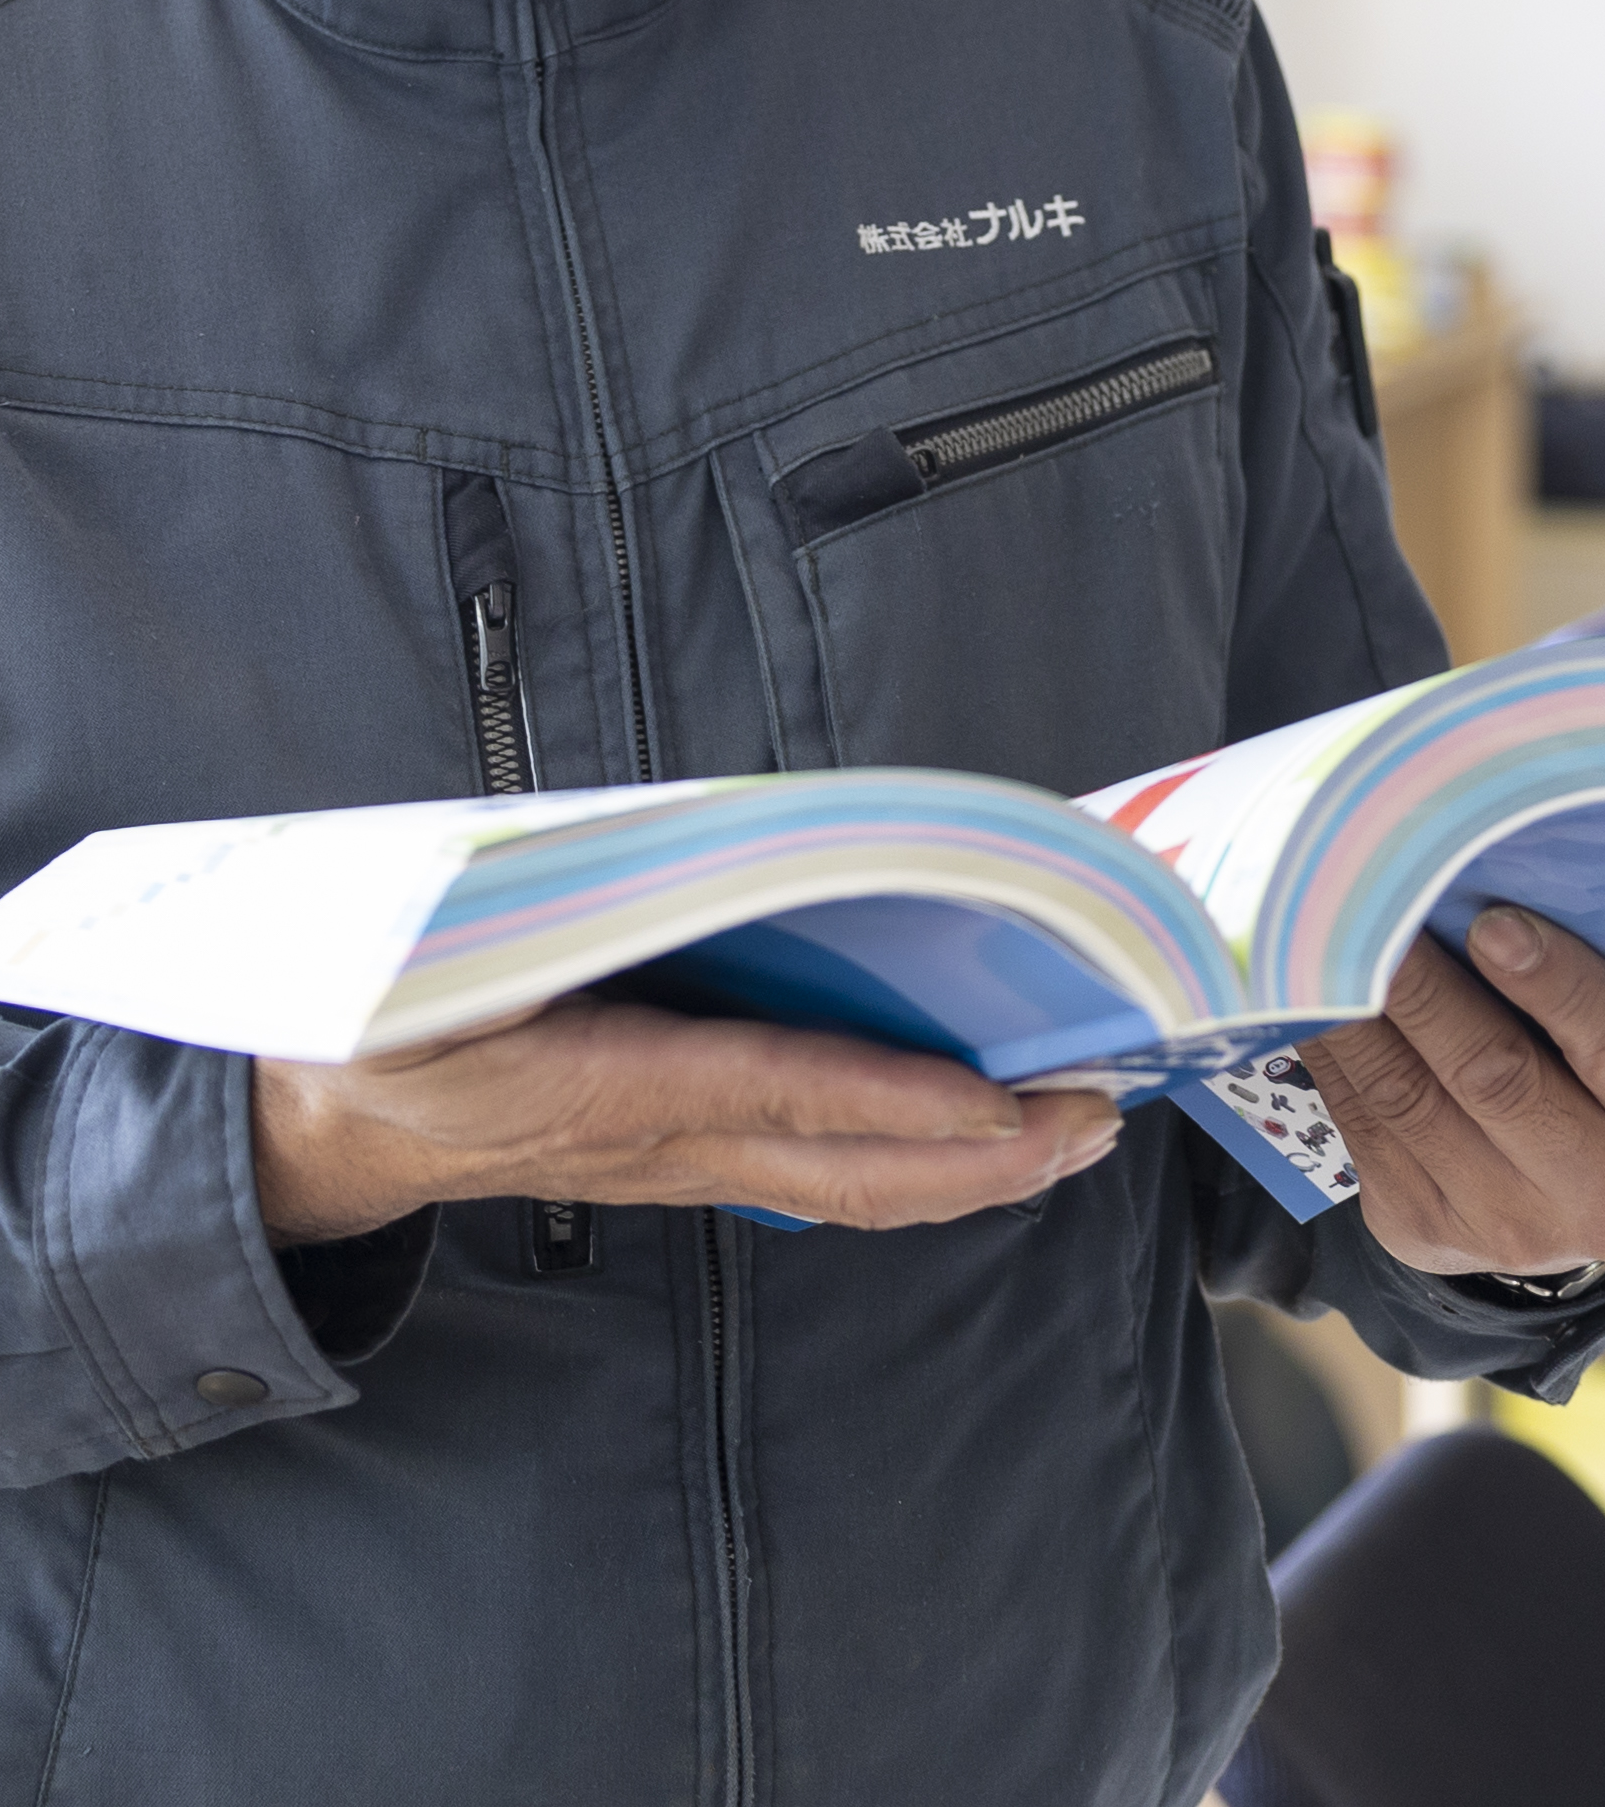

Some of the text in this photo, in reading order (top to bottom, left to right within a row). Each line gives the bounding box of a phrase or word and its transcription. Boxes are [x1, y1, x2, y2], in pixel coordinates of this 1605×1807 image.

[857, 195, 1085, 254] 株式会社ナルキ
